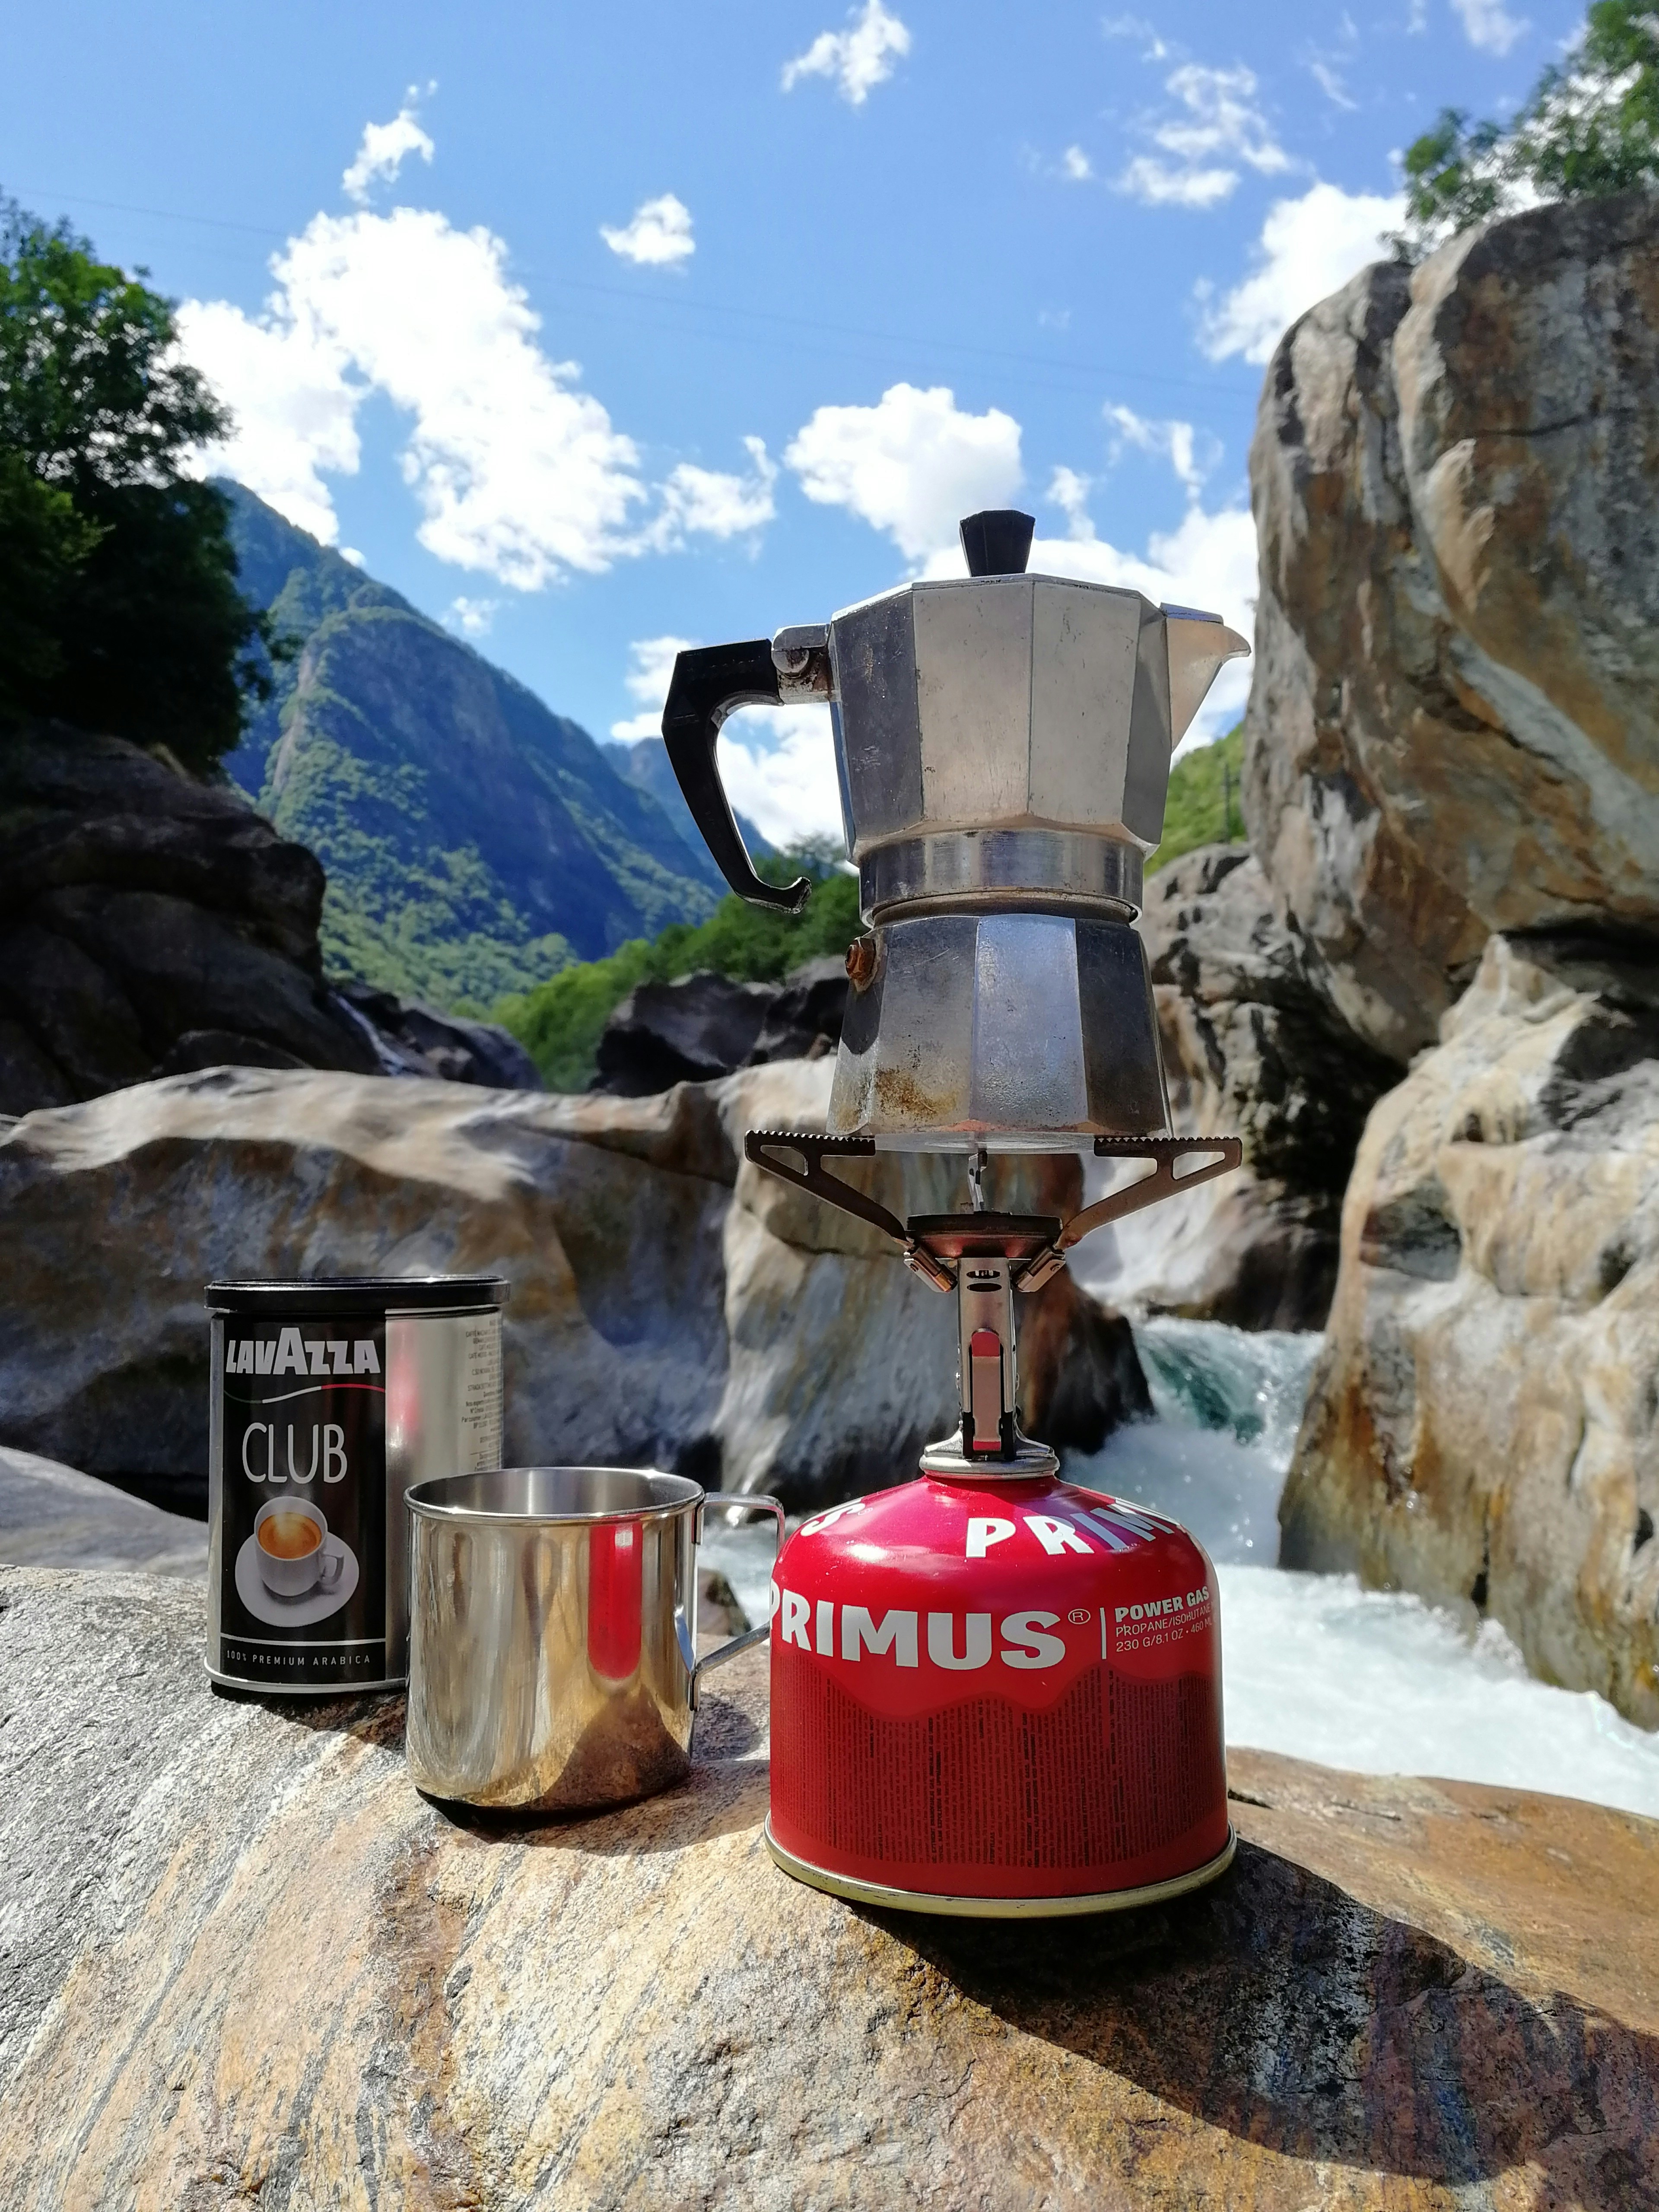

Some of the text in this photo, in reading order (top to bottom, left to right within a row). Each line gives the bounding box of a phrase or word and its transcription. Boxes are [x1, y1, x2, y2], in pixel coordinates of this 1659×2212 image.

[226, 1327, 381, 1375] LAVAZZA
[242, 1422, 347, 1484] CLUB
[1115, 1596, 1184, 1623] POWER
[1186, 1586, 1209, 1607] GAS
[1116, 1639, 1139, 1653] 230
[1143, 1634, 1168, 1647] G/8.1
[1171, 1628, 1183, 1640] OZ
[1191, 1621, 1204, 1633] 460
[227, 1650, 370, 1665] 100% PREMIUM ARABICA
